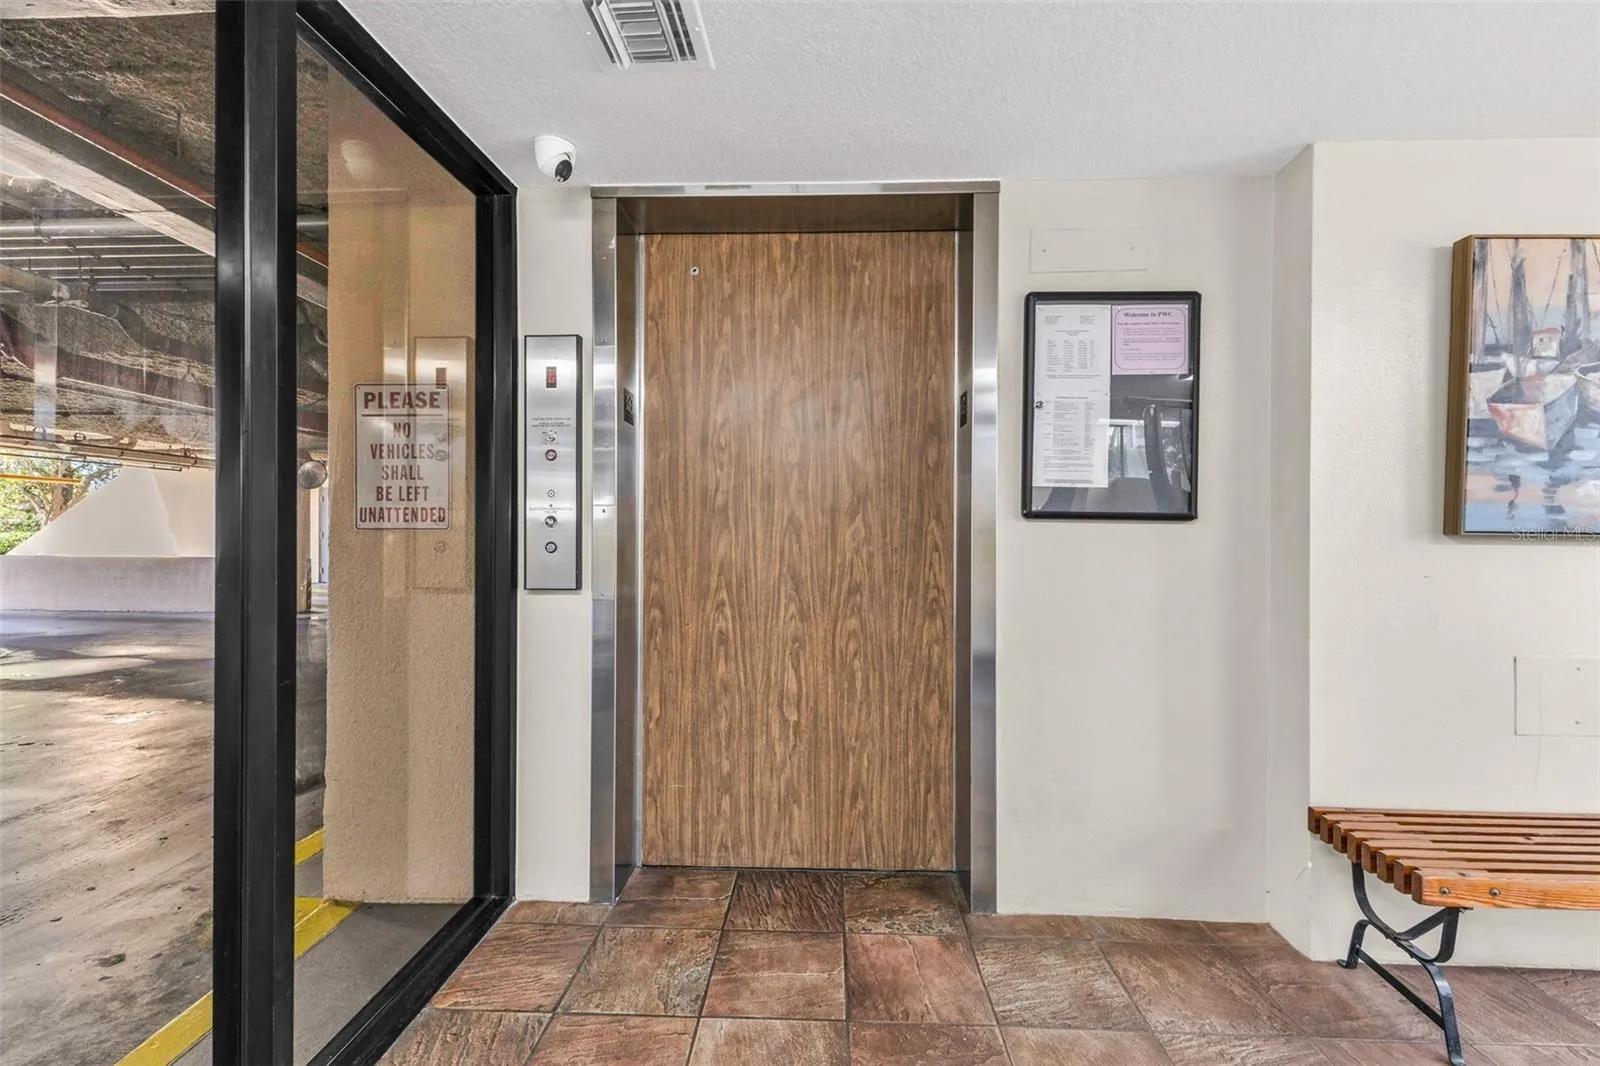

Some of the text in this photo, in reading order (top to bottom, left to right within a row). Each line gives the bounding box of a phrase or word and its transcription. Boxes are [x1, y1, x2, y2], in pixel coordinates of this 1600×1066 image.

[363, 391, 441, 409] PLEASE
[393, 422, 411, 438] NO
[370, 443, 435, 460] VEHICLES
[381, 464, 424, 481] SHALL
[376, 485, 430, 502] BE LEFT
[359, 506, 446, 523] UNATTENDED
